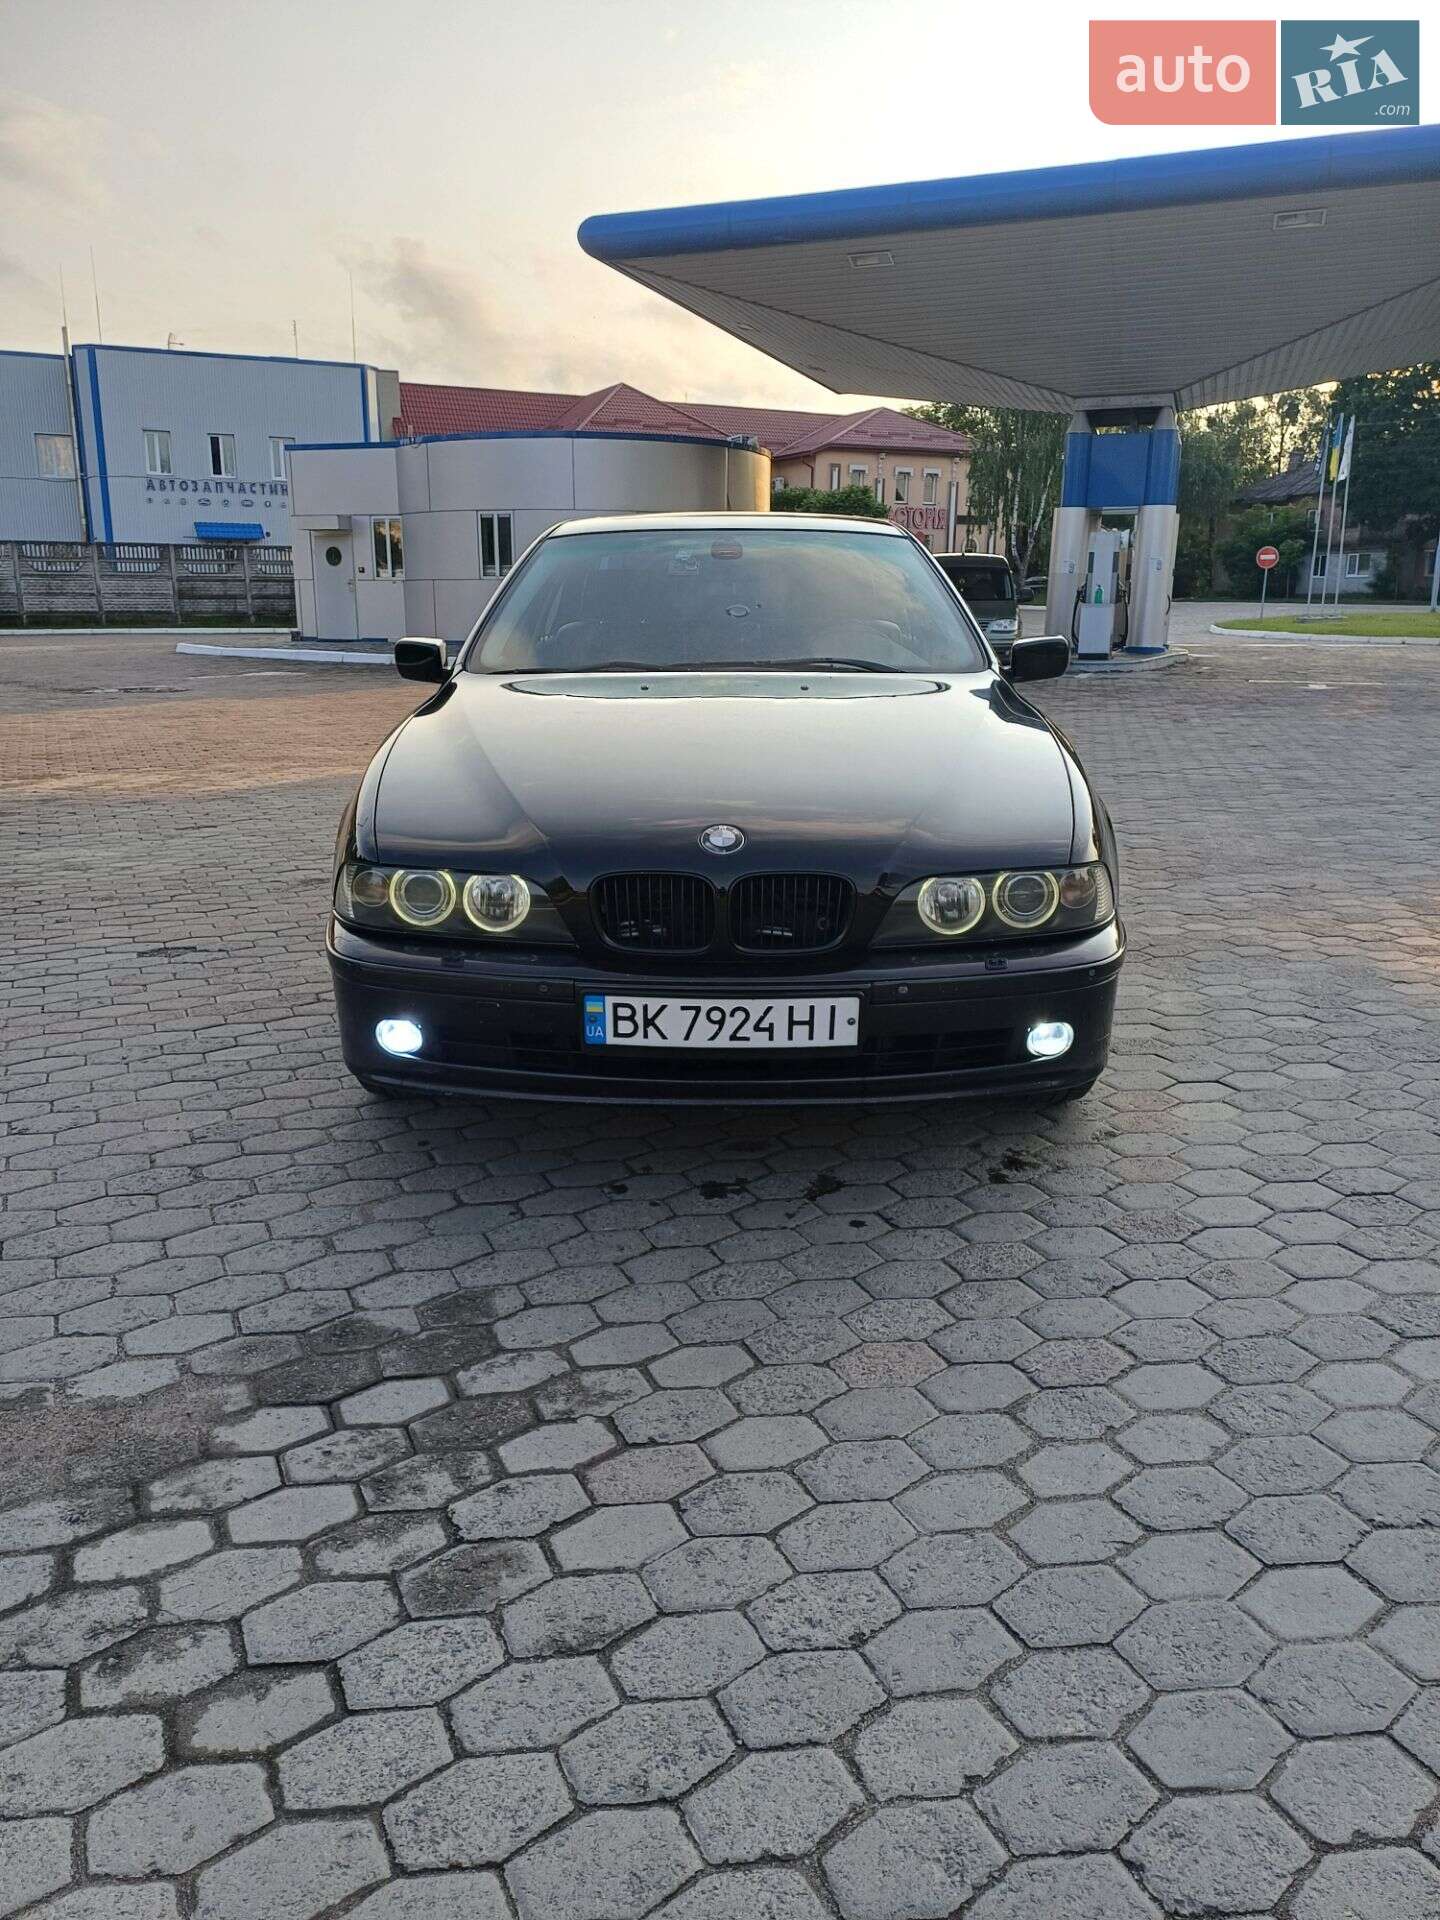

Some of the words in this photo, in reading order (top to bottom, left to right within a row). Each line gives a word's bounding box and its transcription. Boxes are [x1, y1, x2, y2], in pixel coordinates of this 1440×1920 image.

[888, 505, 946, 530] СТОРІЯ
[586, 1026, 604, 1037] UA
[680, 1005, 775, 1042] 7924
